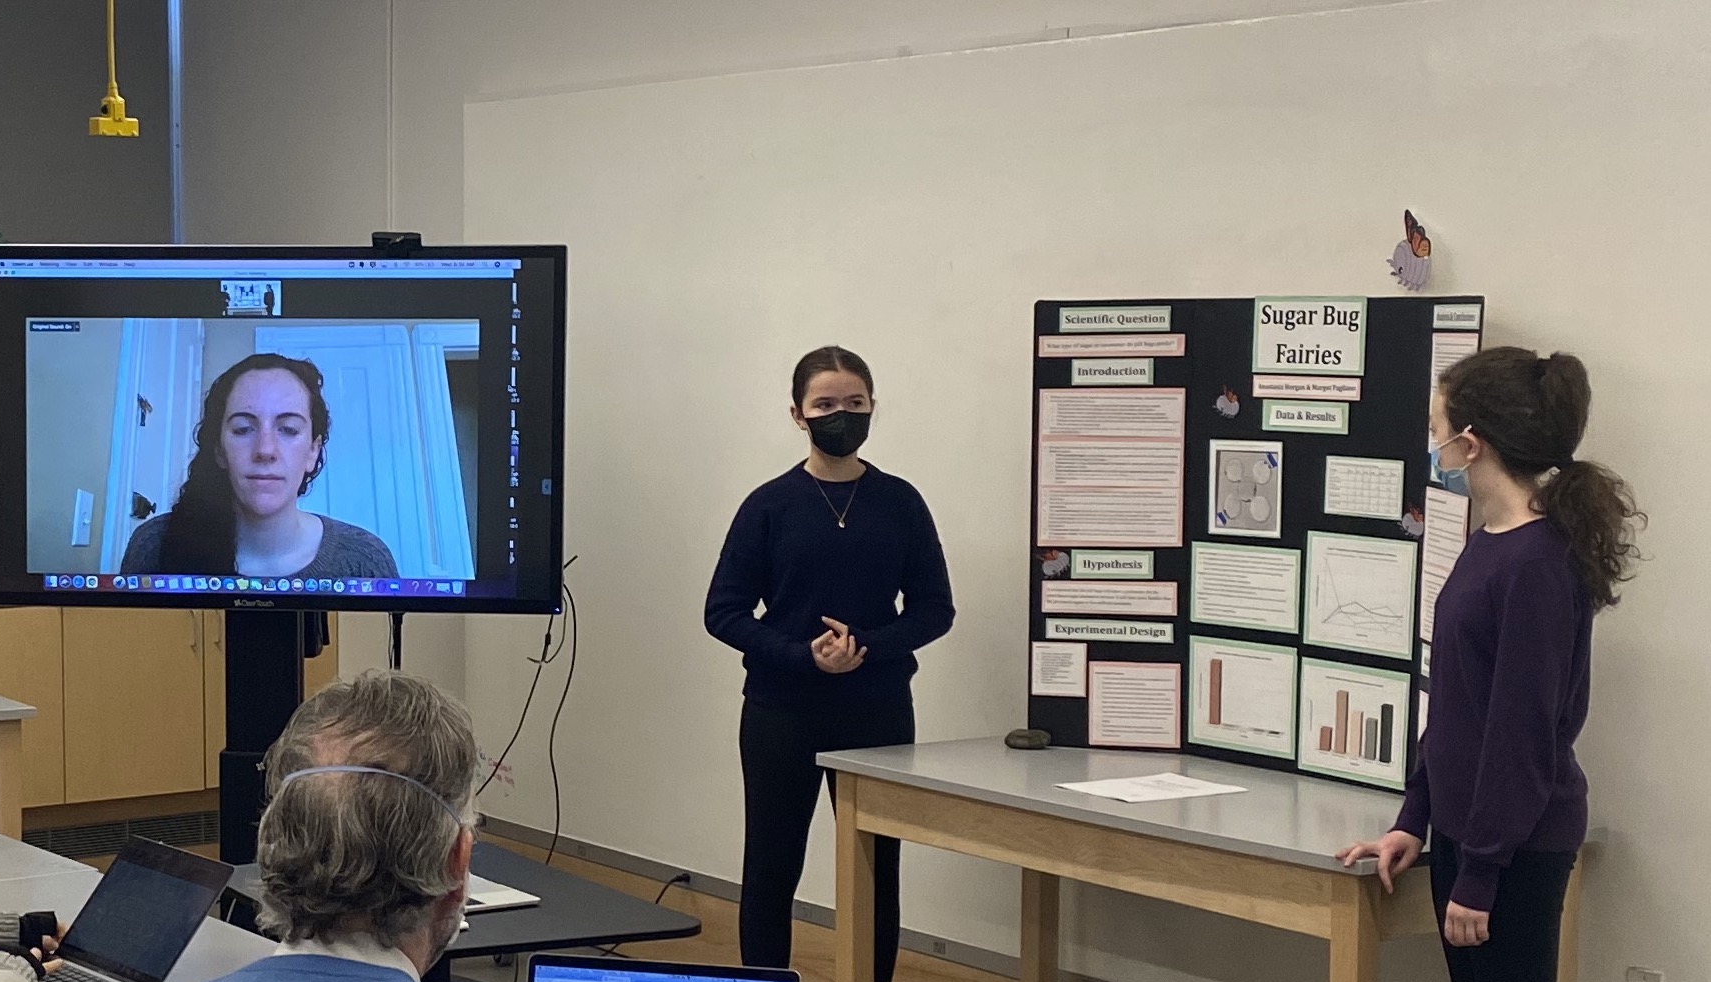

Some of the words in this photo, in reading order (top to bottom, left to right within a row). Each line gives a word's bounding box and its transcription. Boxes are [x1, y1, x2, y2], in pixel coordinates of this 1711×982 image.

[1065, 314, 1115, 325] Scientific
[1116, 314, 1166, 325] Question
[1261, 304, 1318, 331] Sugar
[1323, 305, 1360, 332] Bug
[1275, 343, 1342, 365] Fairies
[1077, 366, 1147, 377] Introduction
[1275, 409, 1295, 420] Data
[1296, 411, 1303, 420] &
[1305, 411, 1337, 422] Results
[1082, 559, 1143, 571] Hypothesis
[1054, 624, 1127, 636] Experimental
[1129, 626, 1167, 638] Design
